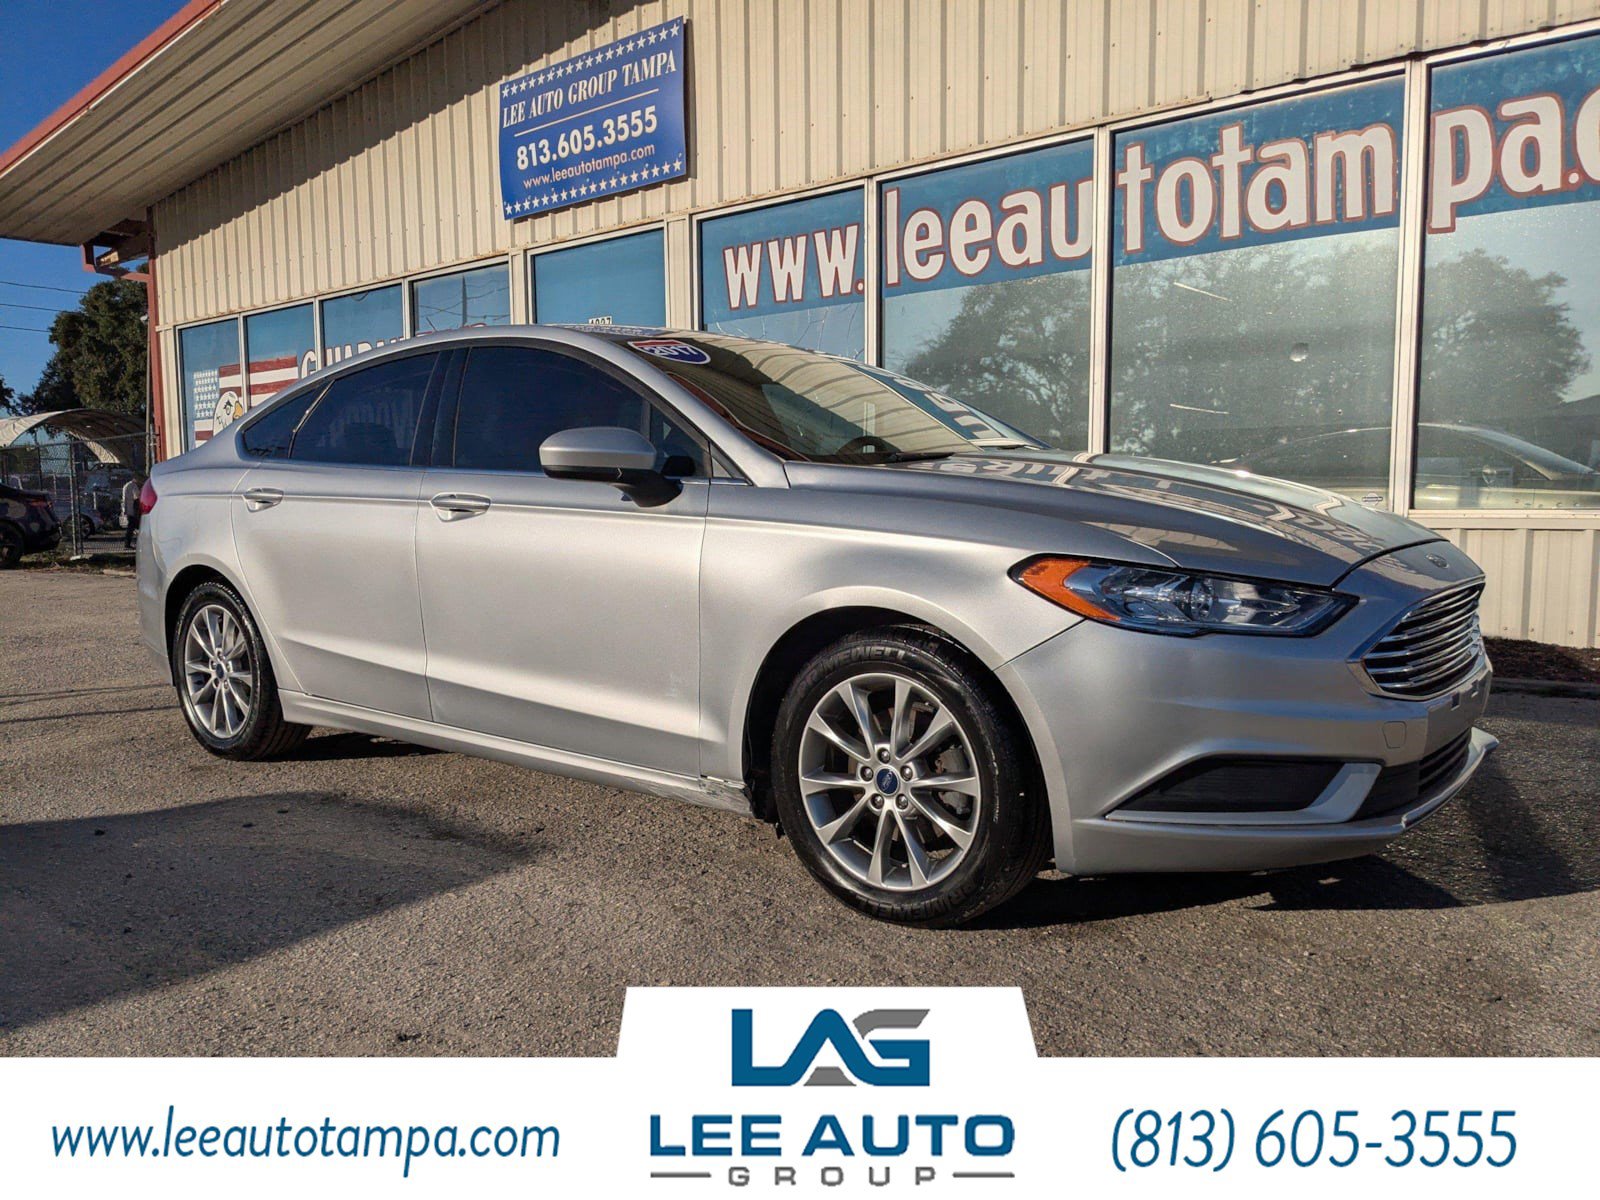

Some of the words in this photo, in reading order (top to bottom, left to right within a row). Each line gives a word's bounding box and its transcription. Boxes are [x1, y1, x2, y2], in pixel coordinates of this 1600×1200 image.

[502, 101, 526, 129] LEE
[528, 88, 563, 119] AUTO
[567, 69, 618, 105] GROUP
[622, 49, 677, 87] TAMPA
[516, 105, 658, 170] 813.605.3555
[523, 143, 655, 190] www.leeautotampa.com
